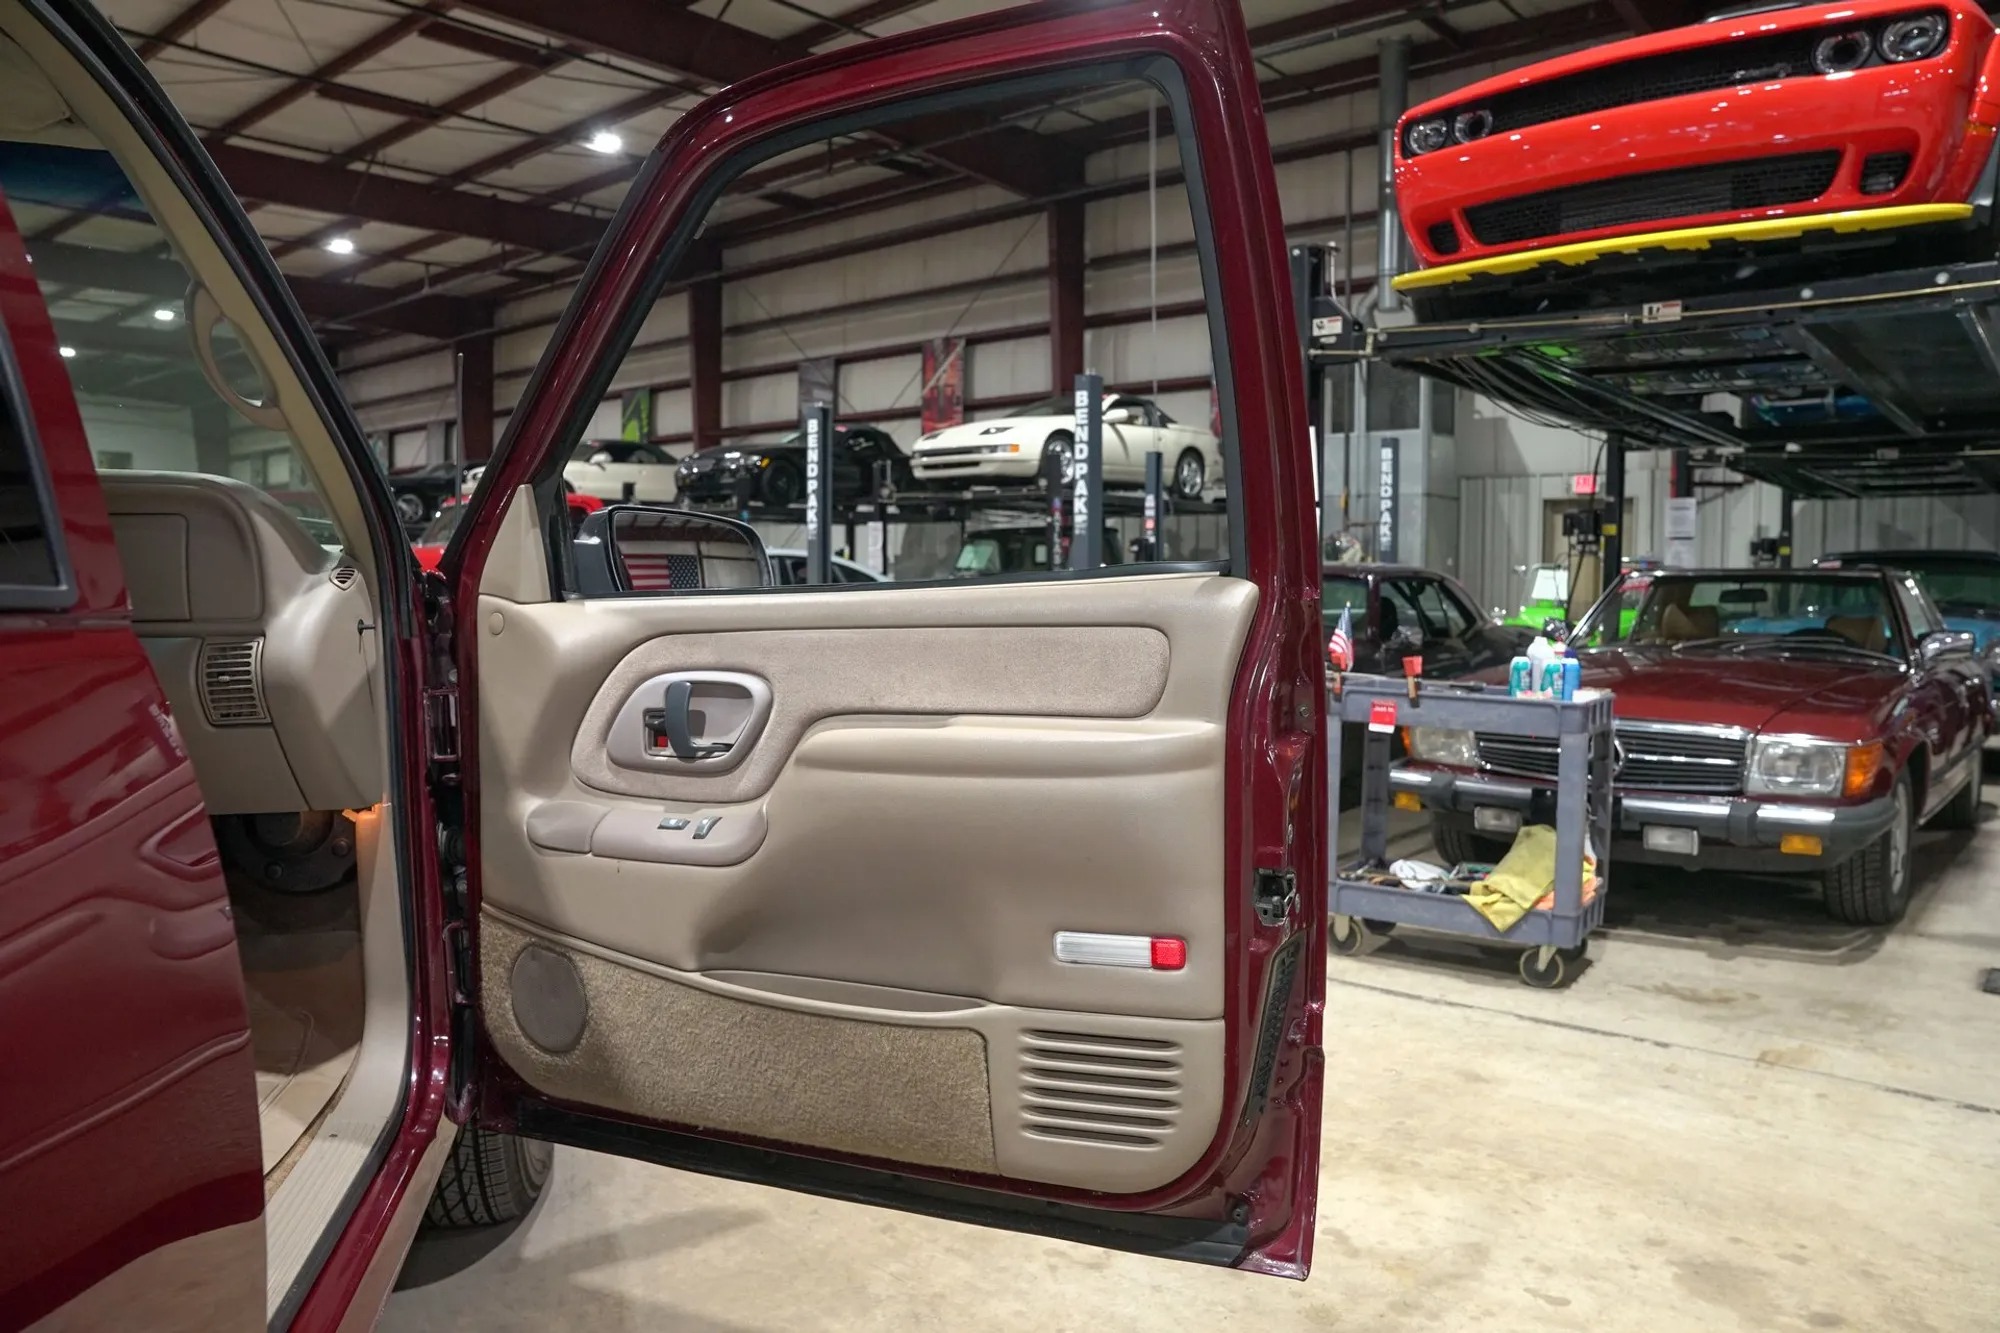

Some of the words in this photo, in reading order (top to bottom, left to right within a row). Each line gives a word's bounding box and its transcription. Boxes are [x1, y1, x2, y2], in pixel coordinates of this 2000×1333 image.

[807, 418, 819, 523] BENDPAK
[1074, 390, 1089, 513] BENDPAK
[1380, 447, 1393, 537] BENDPAK
